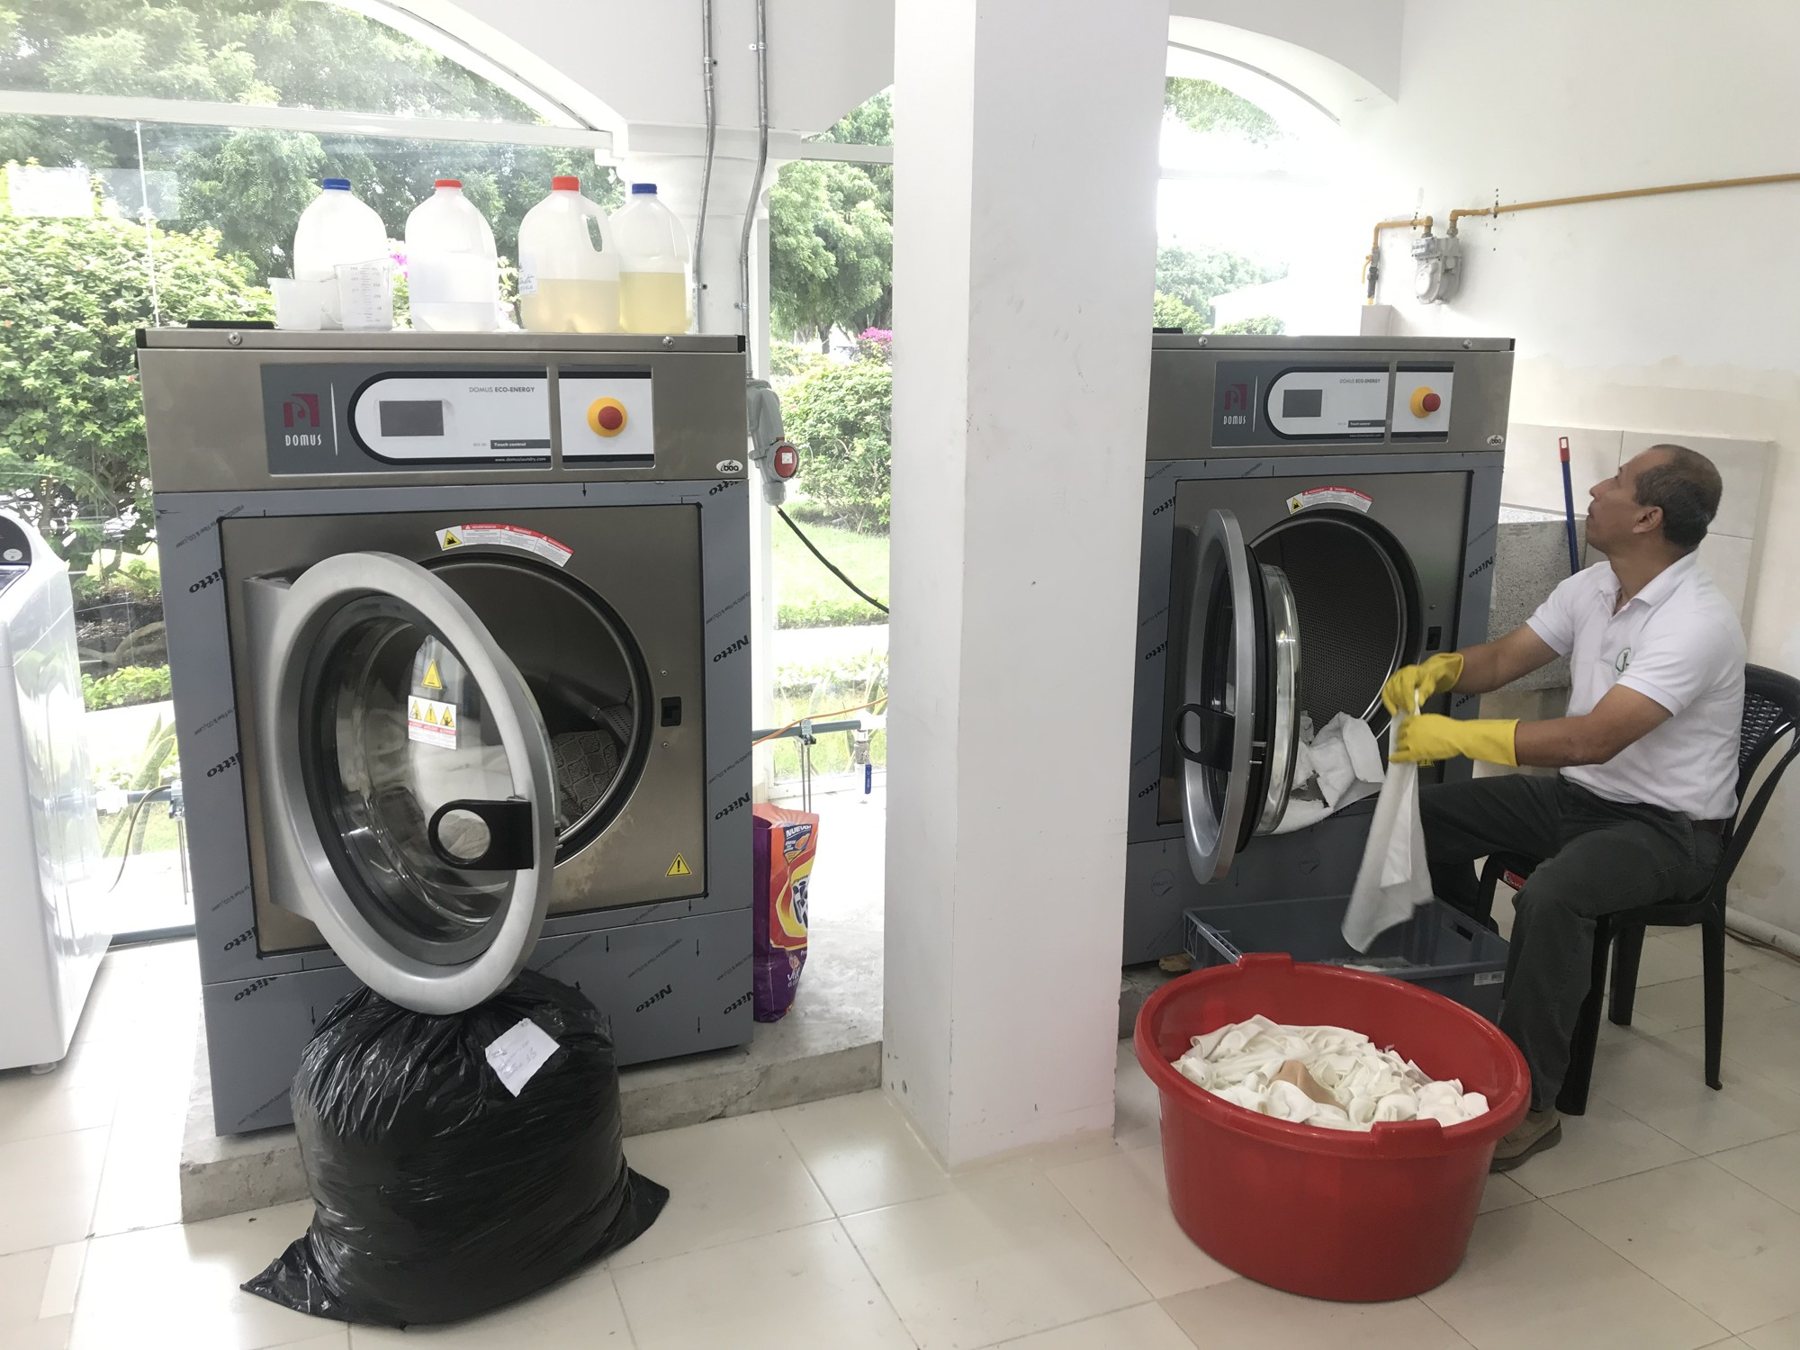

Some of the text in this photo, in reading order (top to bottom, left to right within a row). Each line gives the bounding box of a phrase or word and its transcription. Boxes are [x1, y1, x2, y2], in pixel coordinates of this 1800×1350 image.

[1223, 415, 1246, 425] DOMUS
[284, 434, 322, 446] DOMUS
[713, 634, 749, 662] Nitto
[715, 791, 751, 820] Nitto
[635, 984, 672, 1013] Nitto
